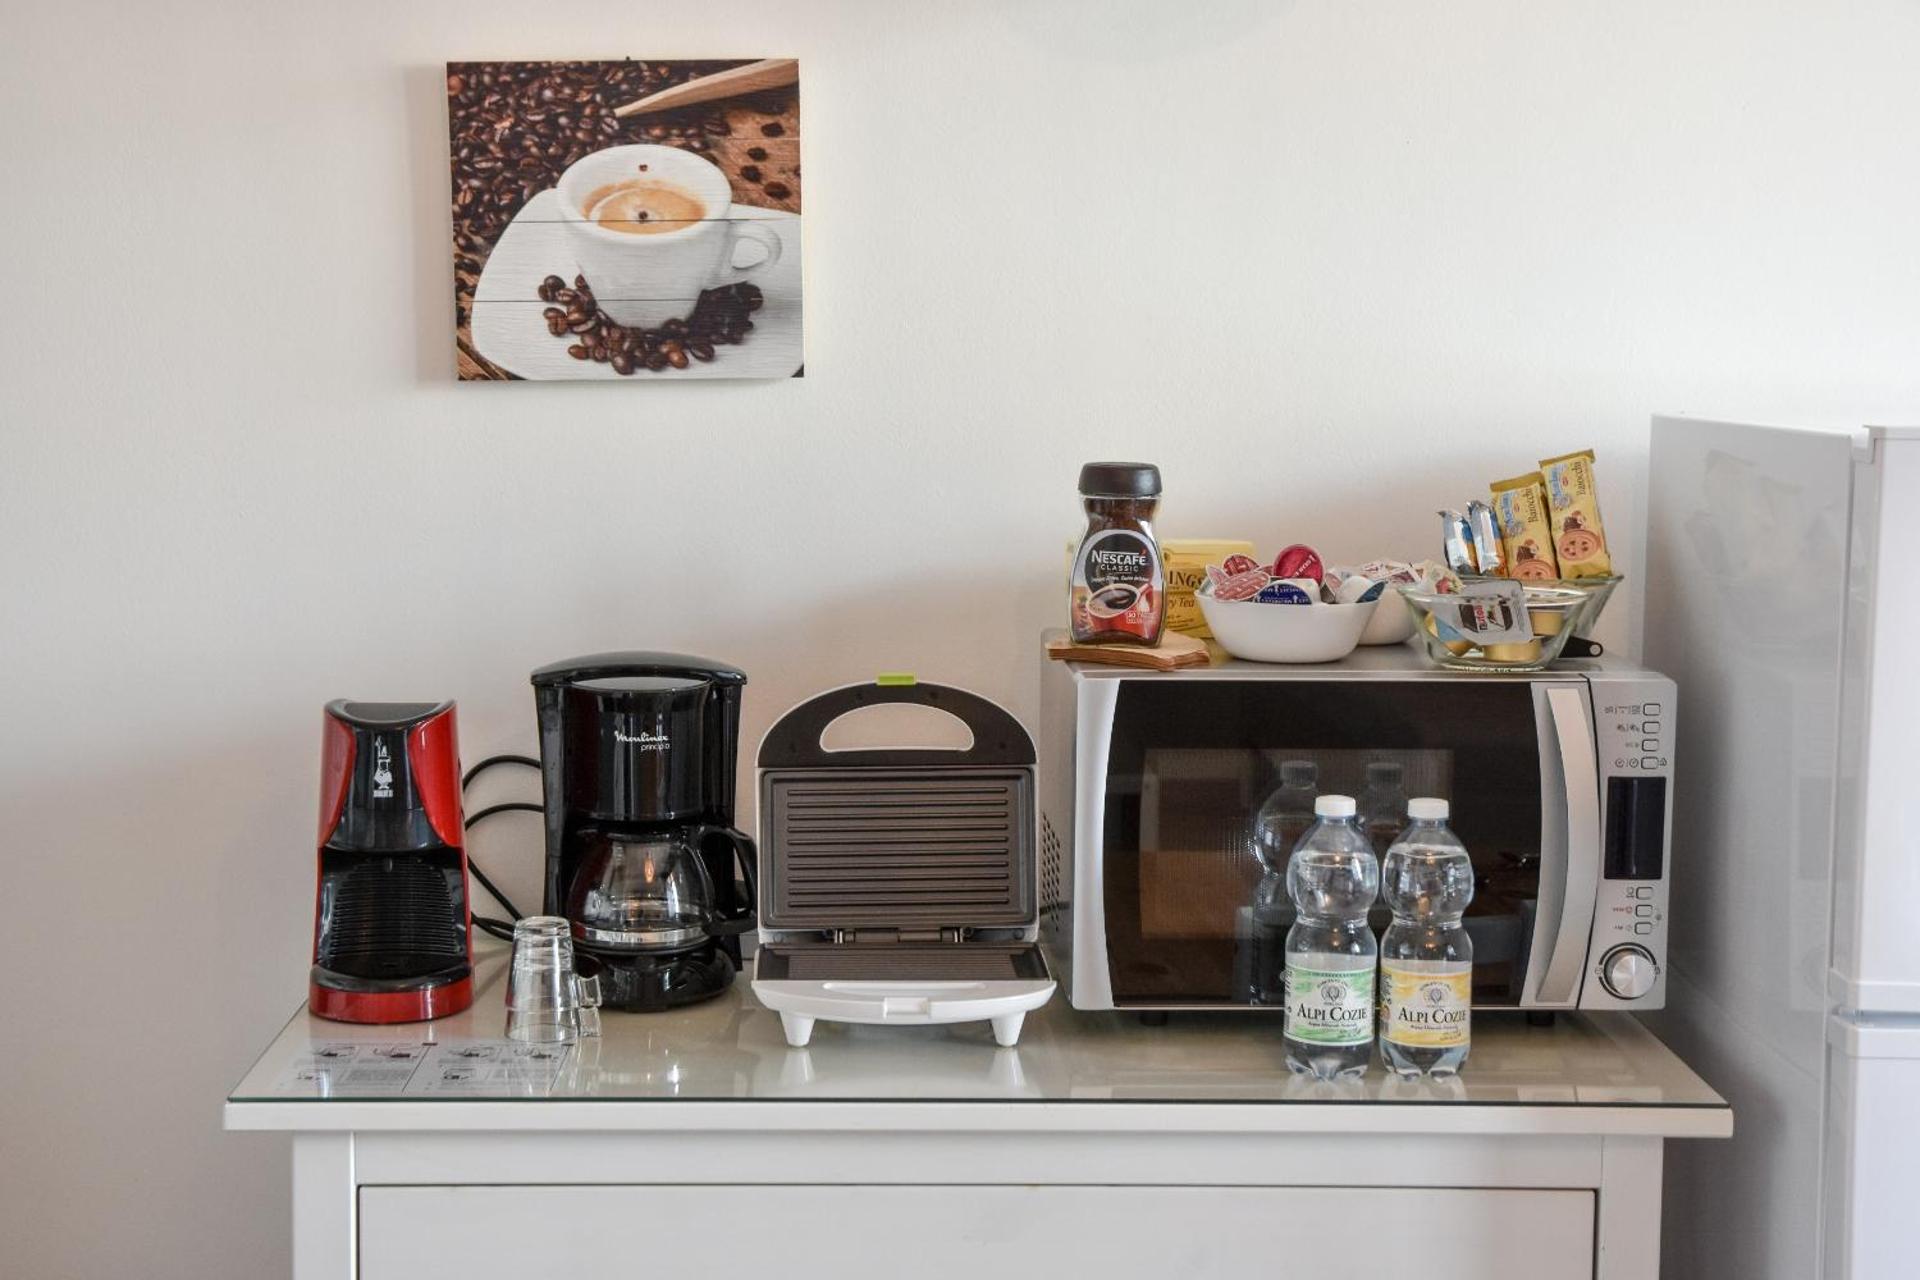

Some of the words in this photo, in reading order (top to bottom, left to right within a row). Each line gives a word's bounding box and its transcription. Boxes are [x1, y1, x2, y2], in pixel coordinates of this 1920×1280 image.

[1100, 564, 1139, 572] CLASSIC
[614, 730, 668, 742] Moulinex
[640, 743, 670, 751] principo
[1297, 1003, 1326, 1021] ALPI
[1329, 1006, 1367, 1021] COZIE
[1398, 1007, 1428, 1023] ALPI
